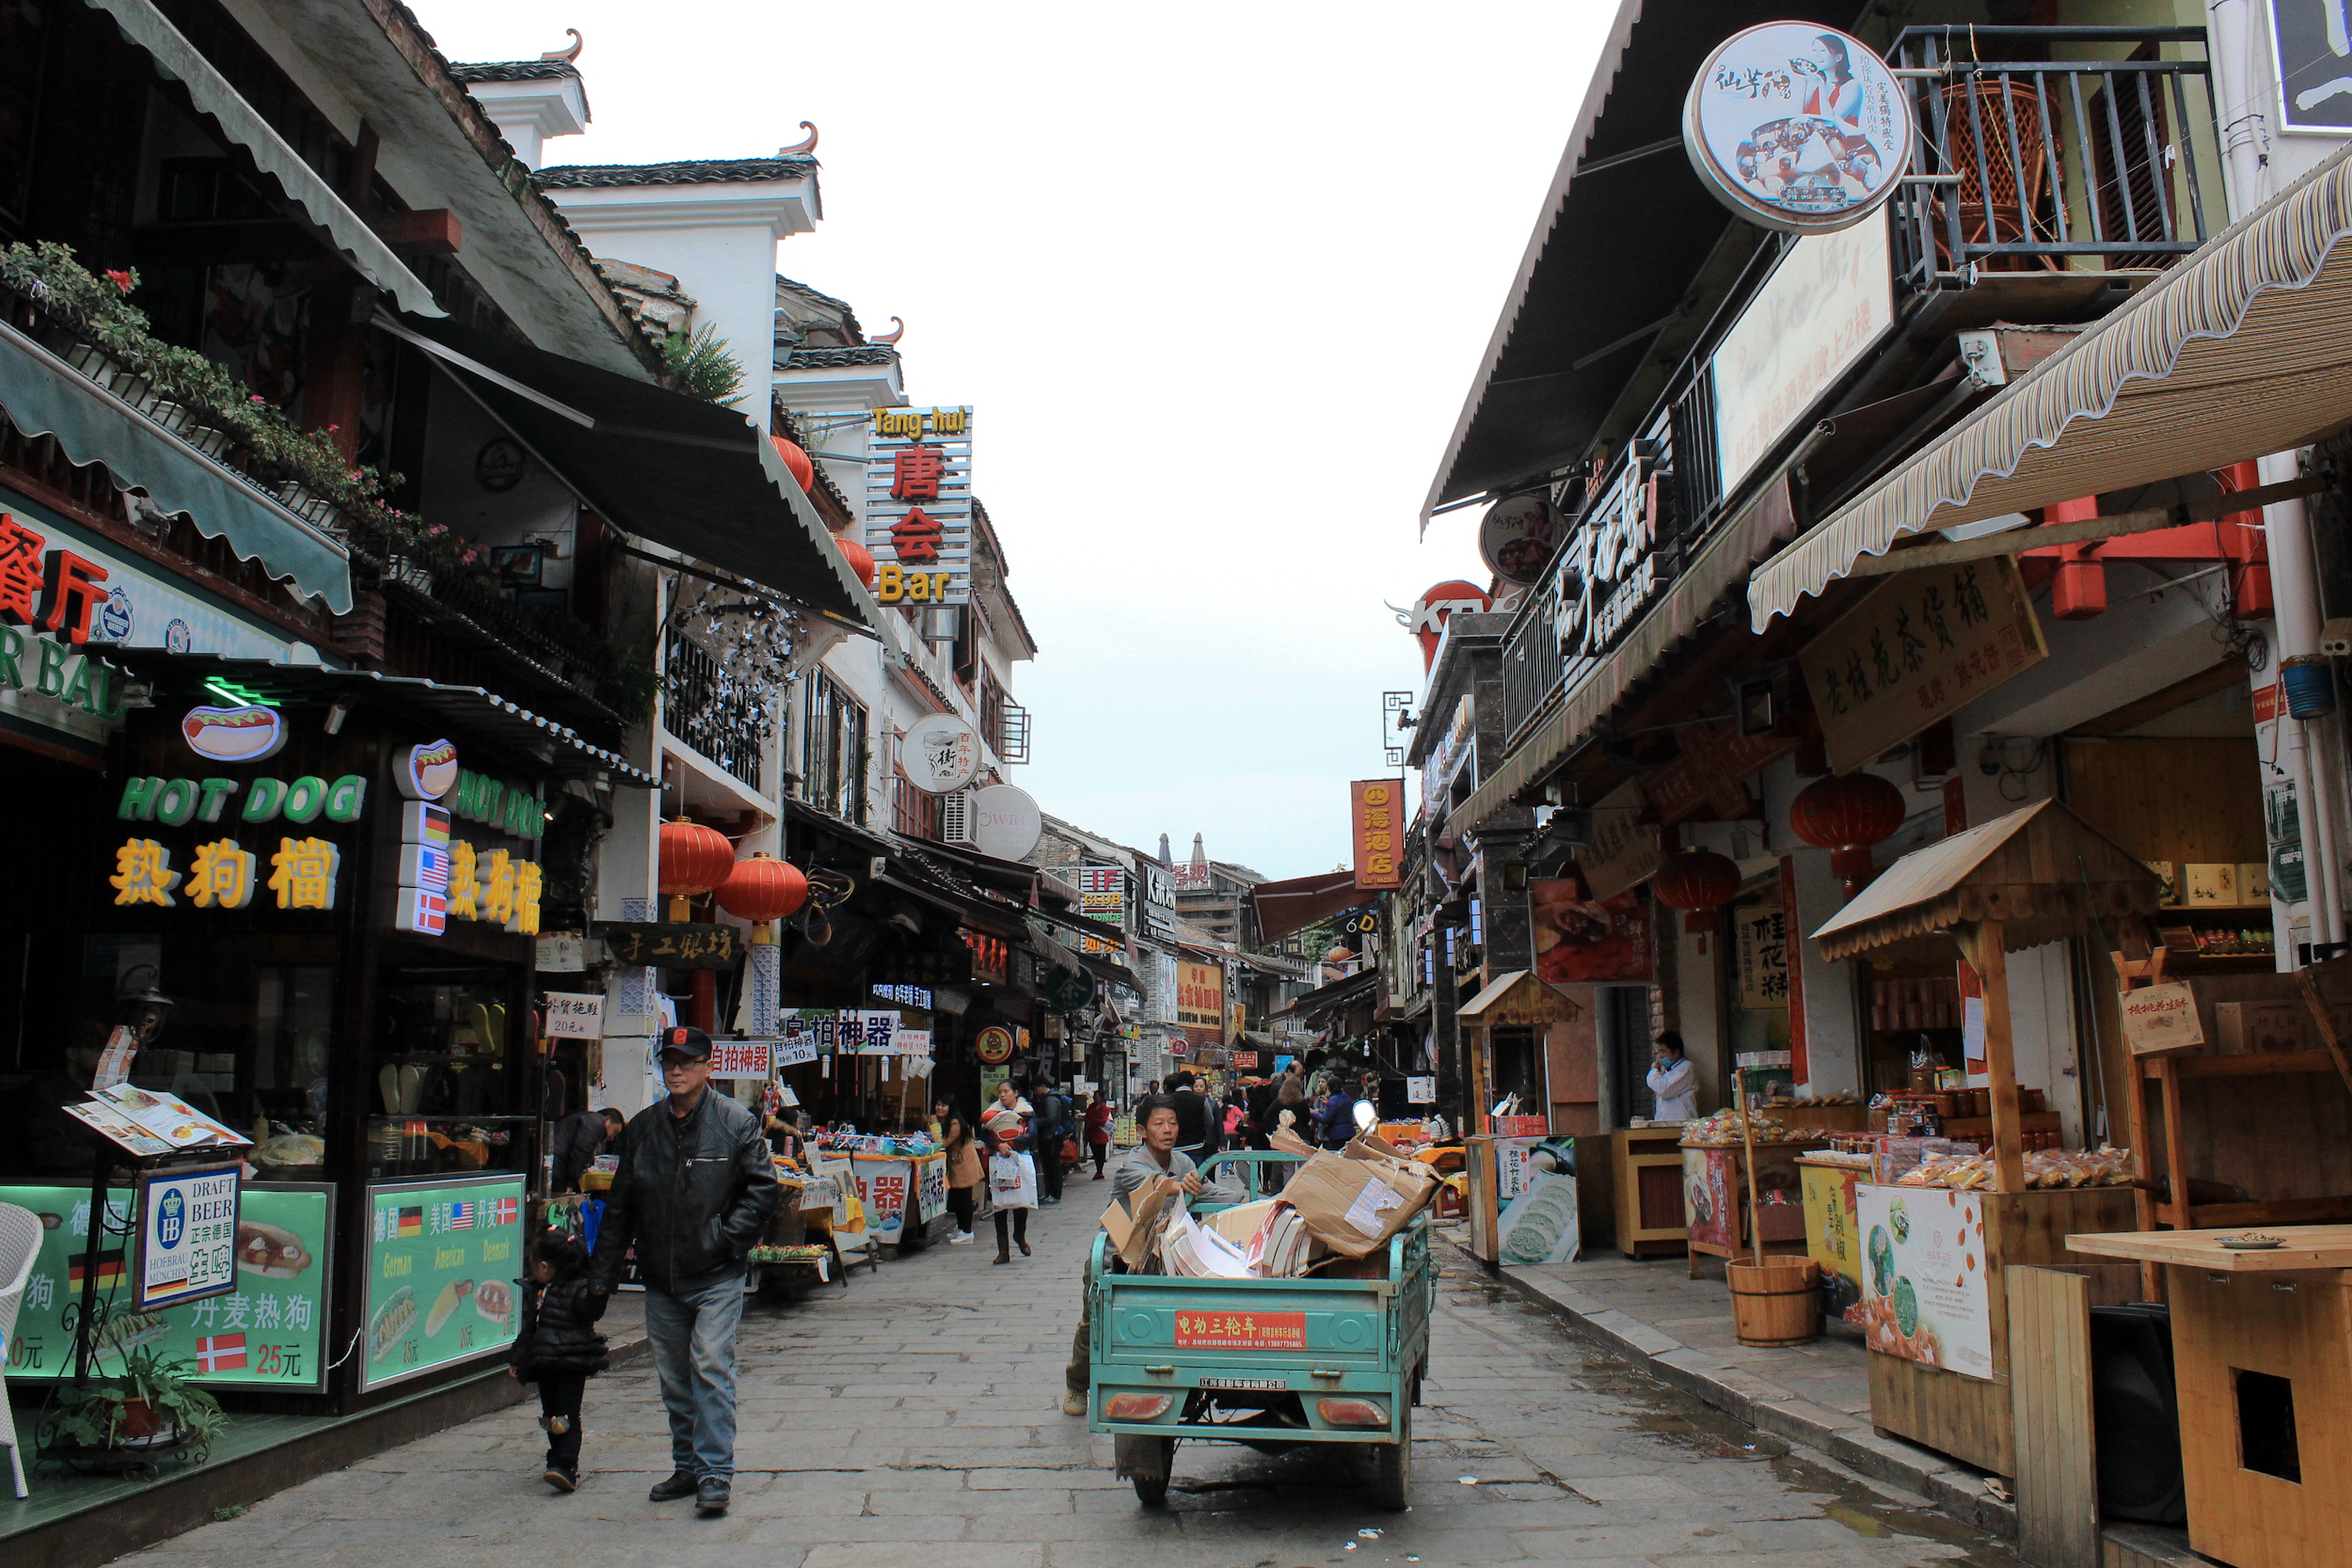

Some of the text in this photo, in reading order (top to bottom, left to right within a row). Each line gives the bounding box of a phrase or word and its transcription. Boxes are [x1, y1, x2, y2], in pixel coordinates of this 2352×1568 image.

[873, 406, 966, 439] Tang hui
[890, 447, 945, 563] 唐会
[0, 513, 109, 645] 餐厅
[879, 565, 950, 603] Bar
[956, 733, 972, 780] 百年特产
[117, 774, 366, 826] HOT DOG
[455, 768, 547, 839] HOT DOG
[1363, 784, 1394, 875] 四海酒店
[1092, 870, 1118, 891] IF
[1084, 893, 1121, 906] CLUB
[1085, 913, 1122, 922] OUNGE
[774, 1032, 815, 1052] 自拍神器
[787, 1015, 893, 1048] 自拍神器
[711, 1045, 769, 1074] 自拍神器
[192, 1178, 235, 1198] DRAFT
[70, 1198, 137, 1238] 德国
[192, 1198, 233, 1223] BEER
[373, 1205, 400, 1244] 德国
[429, 1201, 453, 1236] 美国
[475, 1196, 498, 1230] 丹麦
[190, 1221, 232, 1244] 正宗德国
[150, 1252, 188, 1271] HOFBRÄU
[189, 1244, 231, 1286] 生啤
[383, 1252, 412, 1278] German
[434, 1243, 466, 1271] American
[483, 1237, 510, 1263] Denmark
[149, 1266, 188, 1285] MÜNCHEN
[26, 1274, 56, 1311] 狗
[191, 1291, 312, 1333] 丹麦热狗
[1179, 1315, 1258, 1338] 电动三轮车
[256, 1342, 301, 1378] 25元
[403, 1338, 419, 1364] 25元
